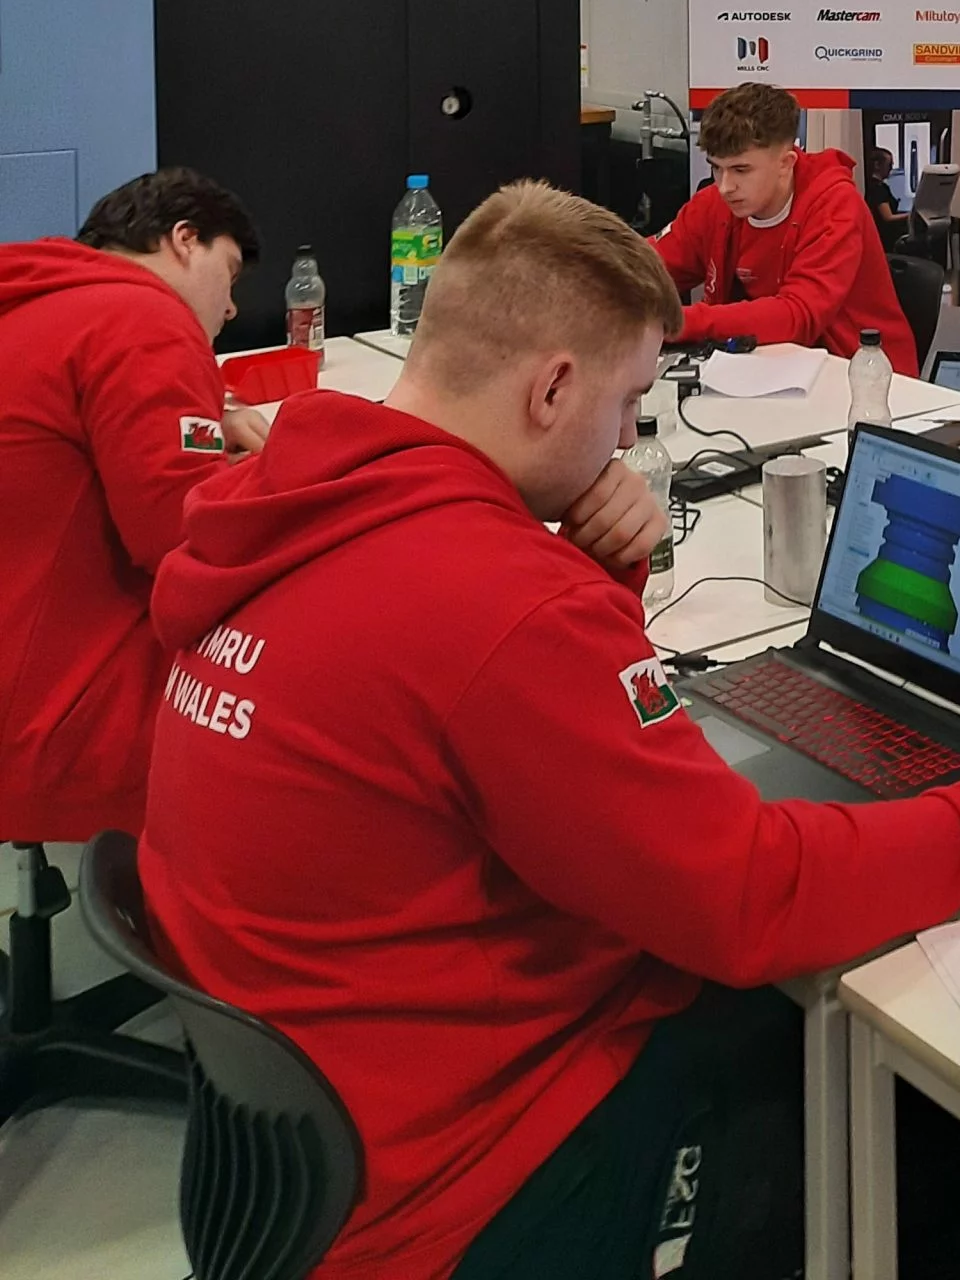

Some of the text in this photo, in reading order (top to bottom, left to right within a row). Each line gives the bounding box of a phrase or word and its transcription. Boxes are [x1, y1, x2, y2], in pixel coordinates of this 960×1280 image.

[731, 12, 791, 22] AUTODESK
[817, 9, 881, 22] Mastercam
[815, 46, 883, 62] QUICKGRIND
[173, 670, 256, 740] WALES
